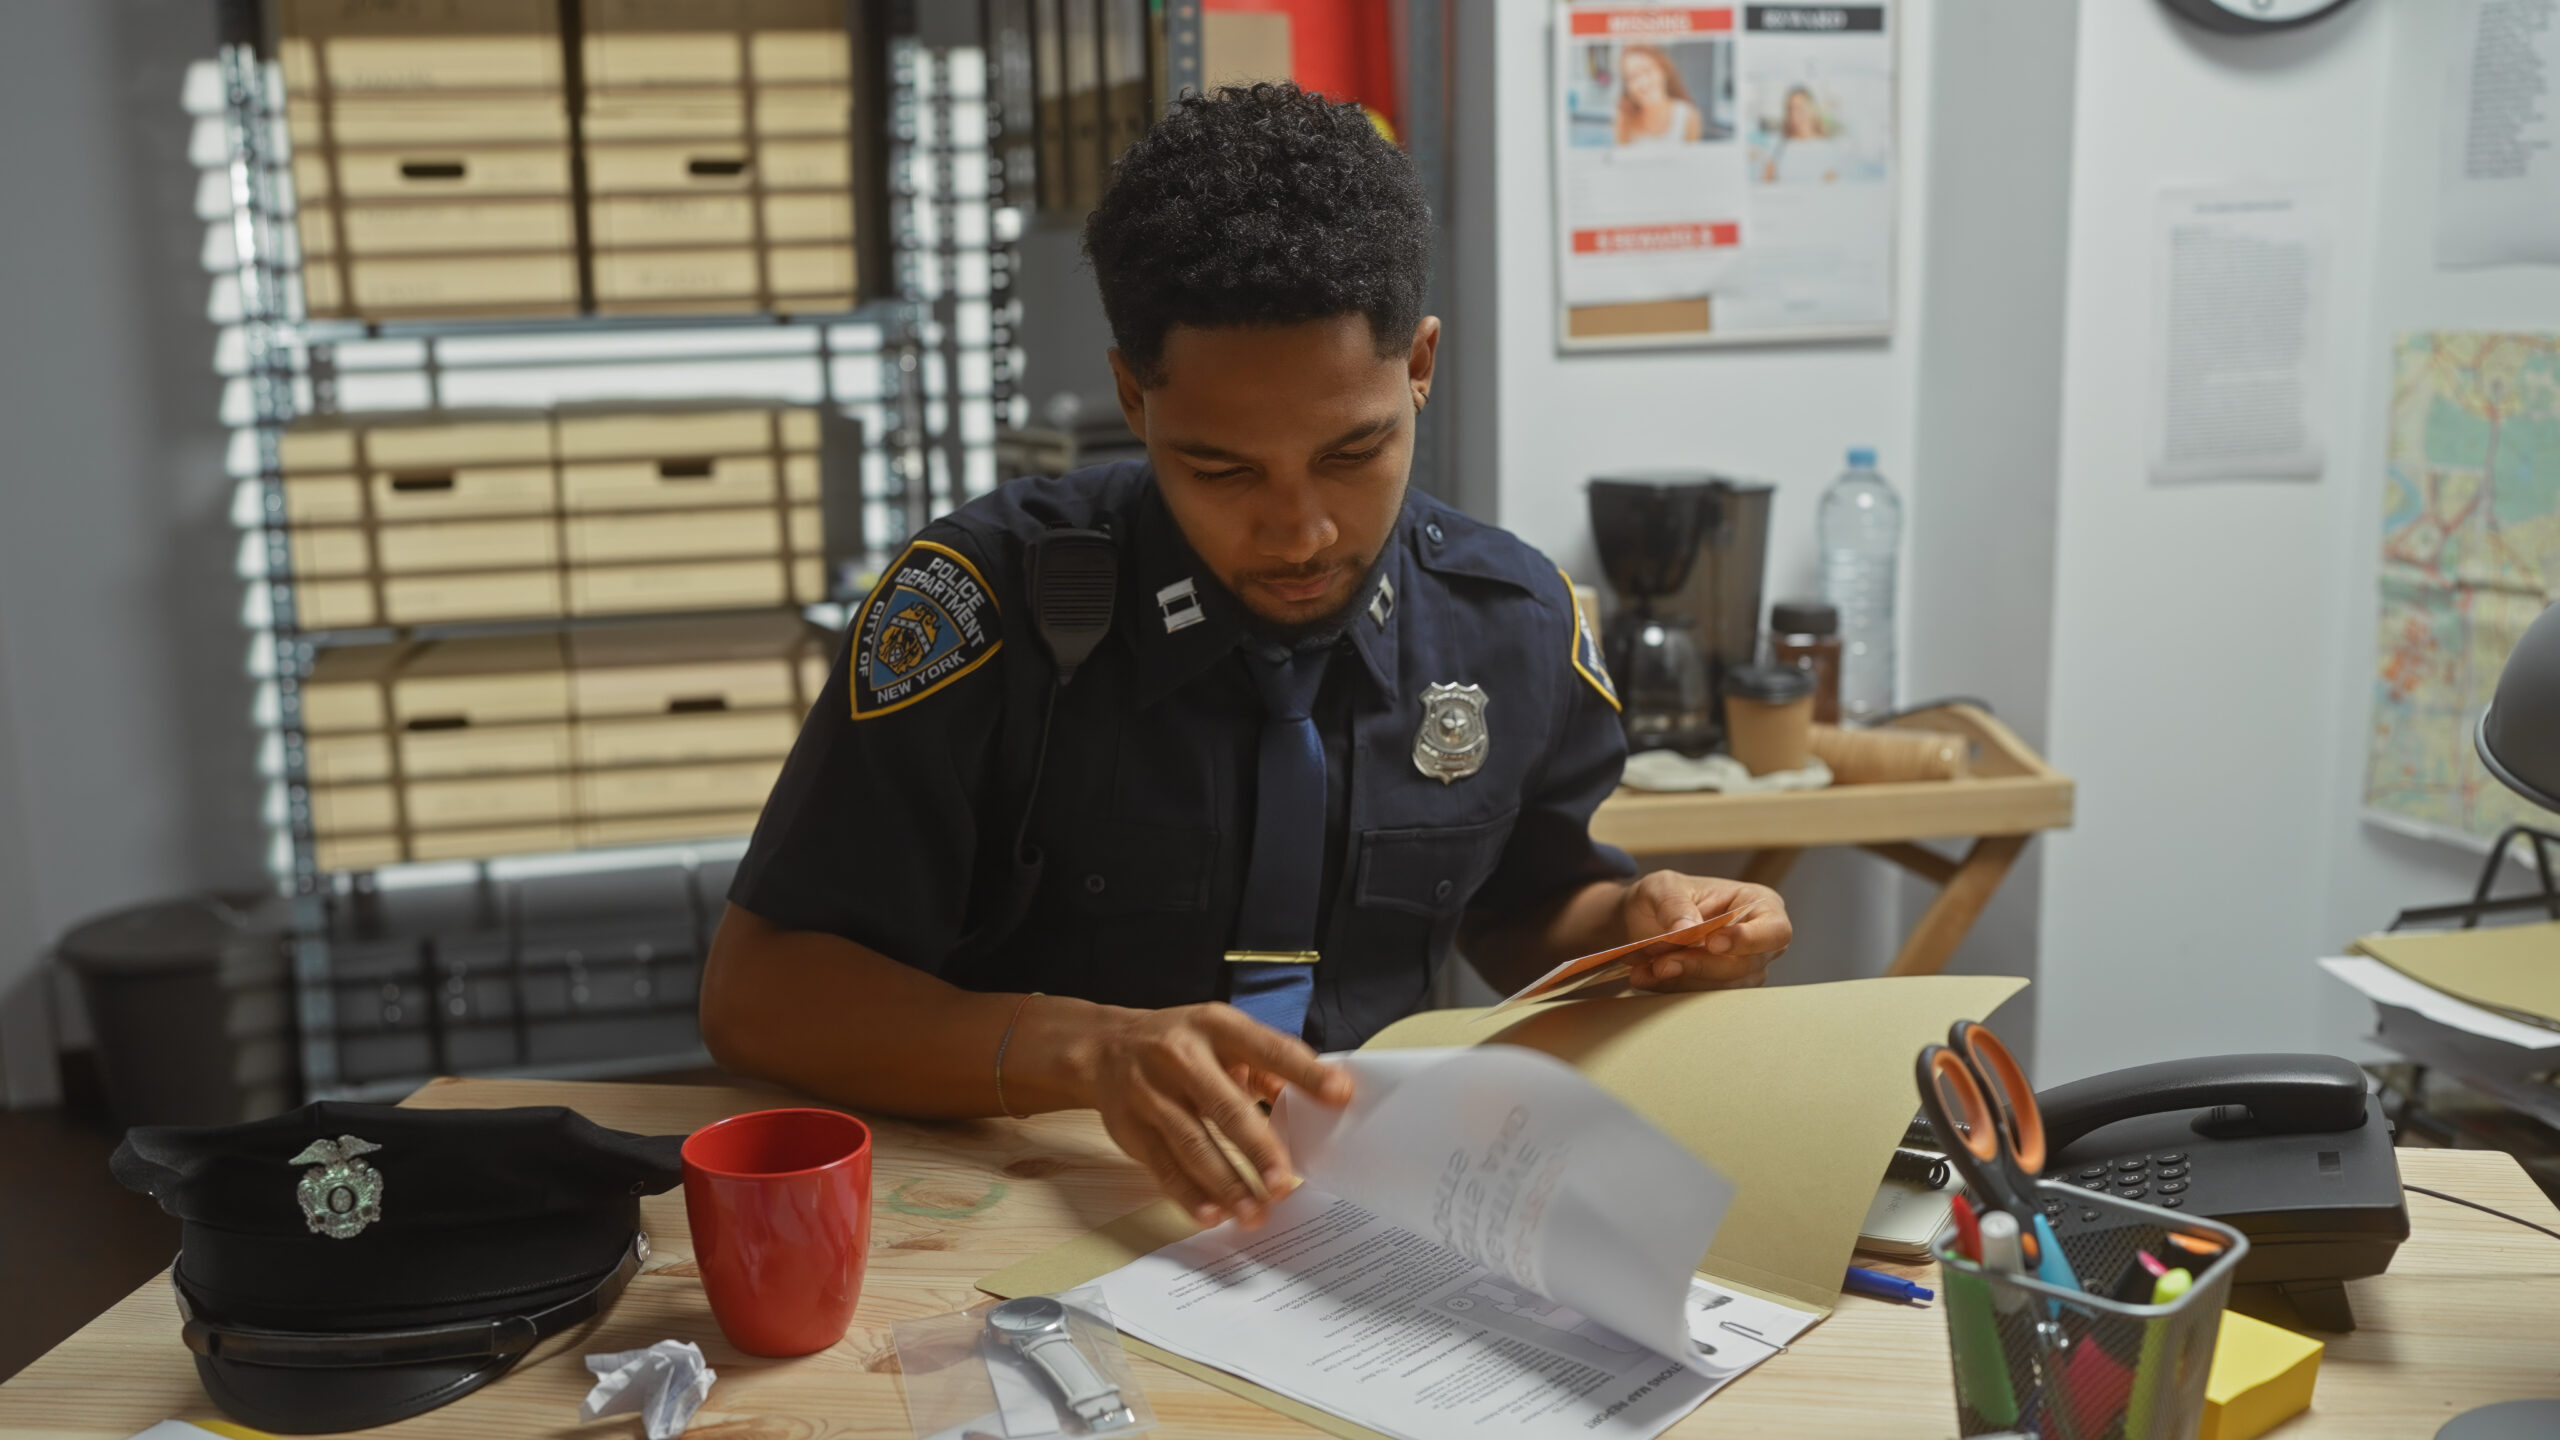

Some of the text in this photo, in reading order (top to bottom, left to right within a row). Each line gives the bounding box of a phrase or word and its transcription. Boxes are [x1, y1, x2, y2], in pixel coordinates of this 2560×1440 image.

[895, 567, 985, 647] DEPARTMENT
[927, 557, 986, 611] POLICE
[859, 601, 886, 677] CITY OF
[877, 650, 966, 704] NEW YORK
[1584, 1362, 1684, 1430] TIONS MAP REPORT
